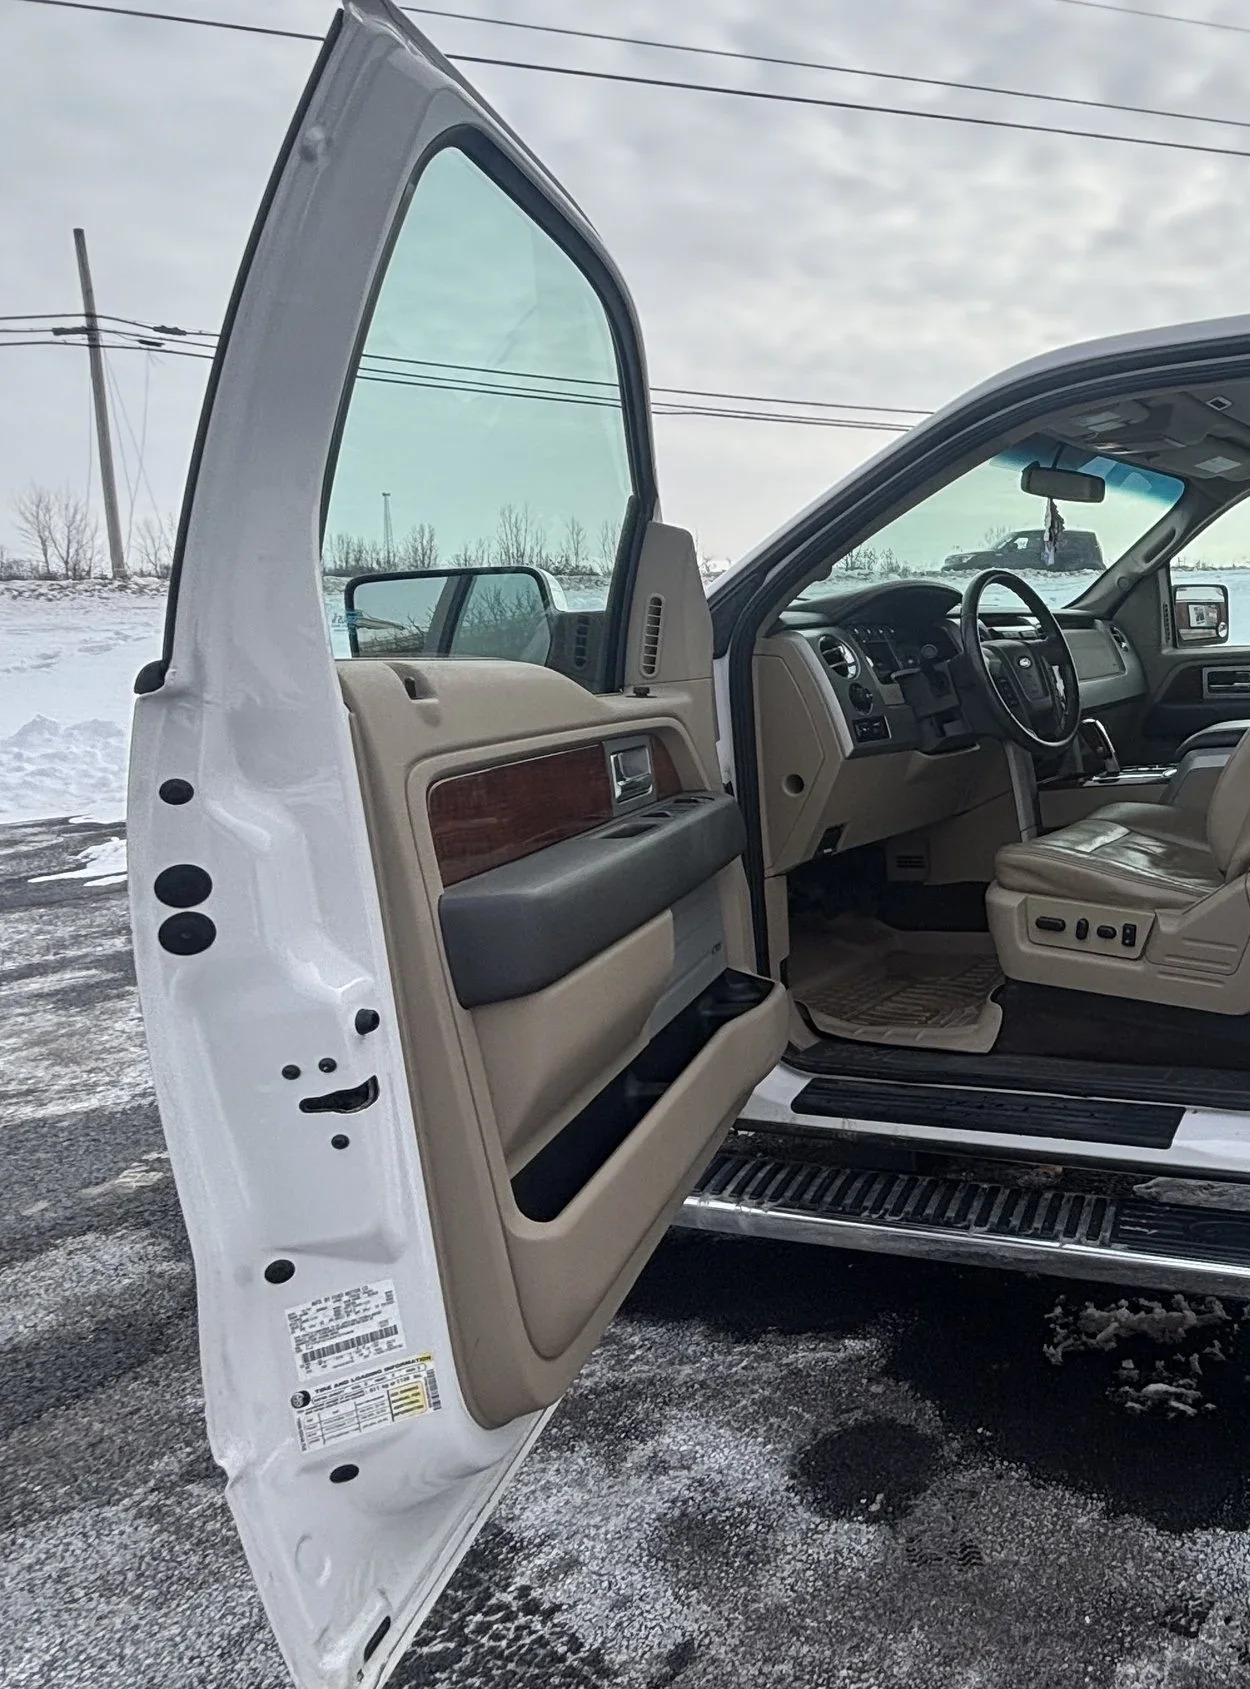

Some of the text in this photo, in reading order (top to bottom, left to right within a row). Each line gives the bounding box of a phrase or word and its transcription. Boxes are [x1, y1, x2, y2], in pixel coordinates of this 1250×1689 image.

[314, 1355, 432, 1394] TIRE AND LOADING INFORMATION
